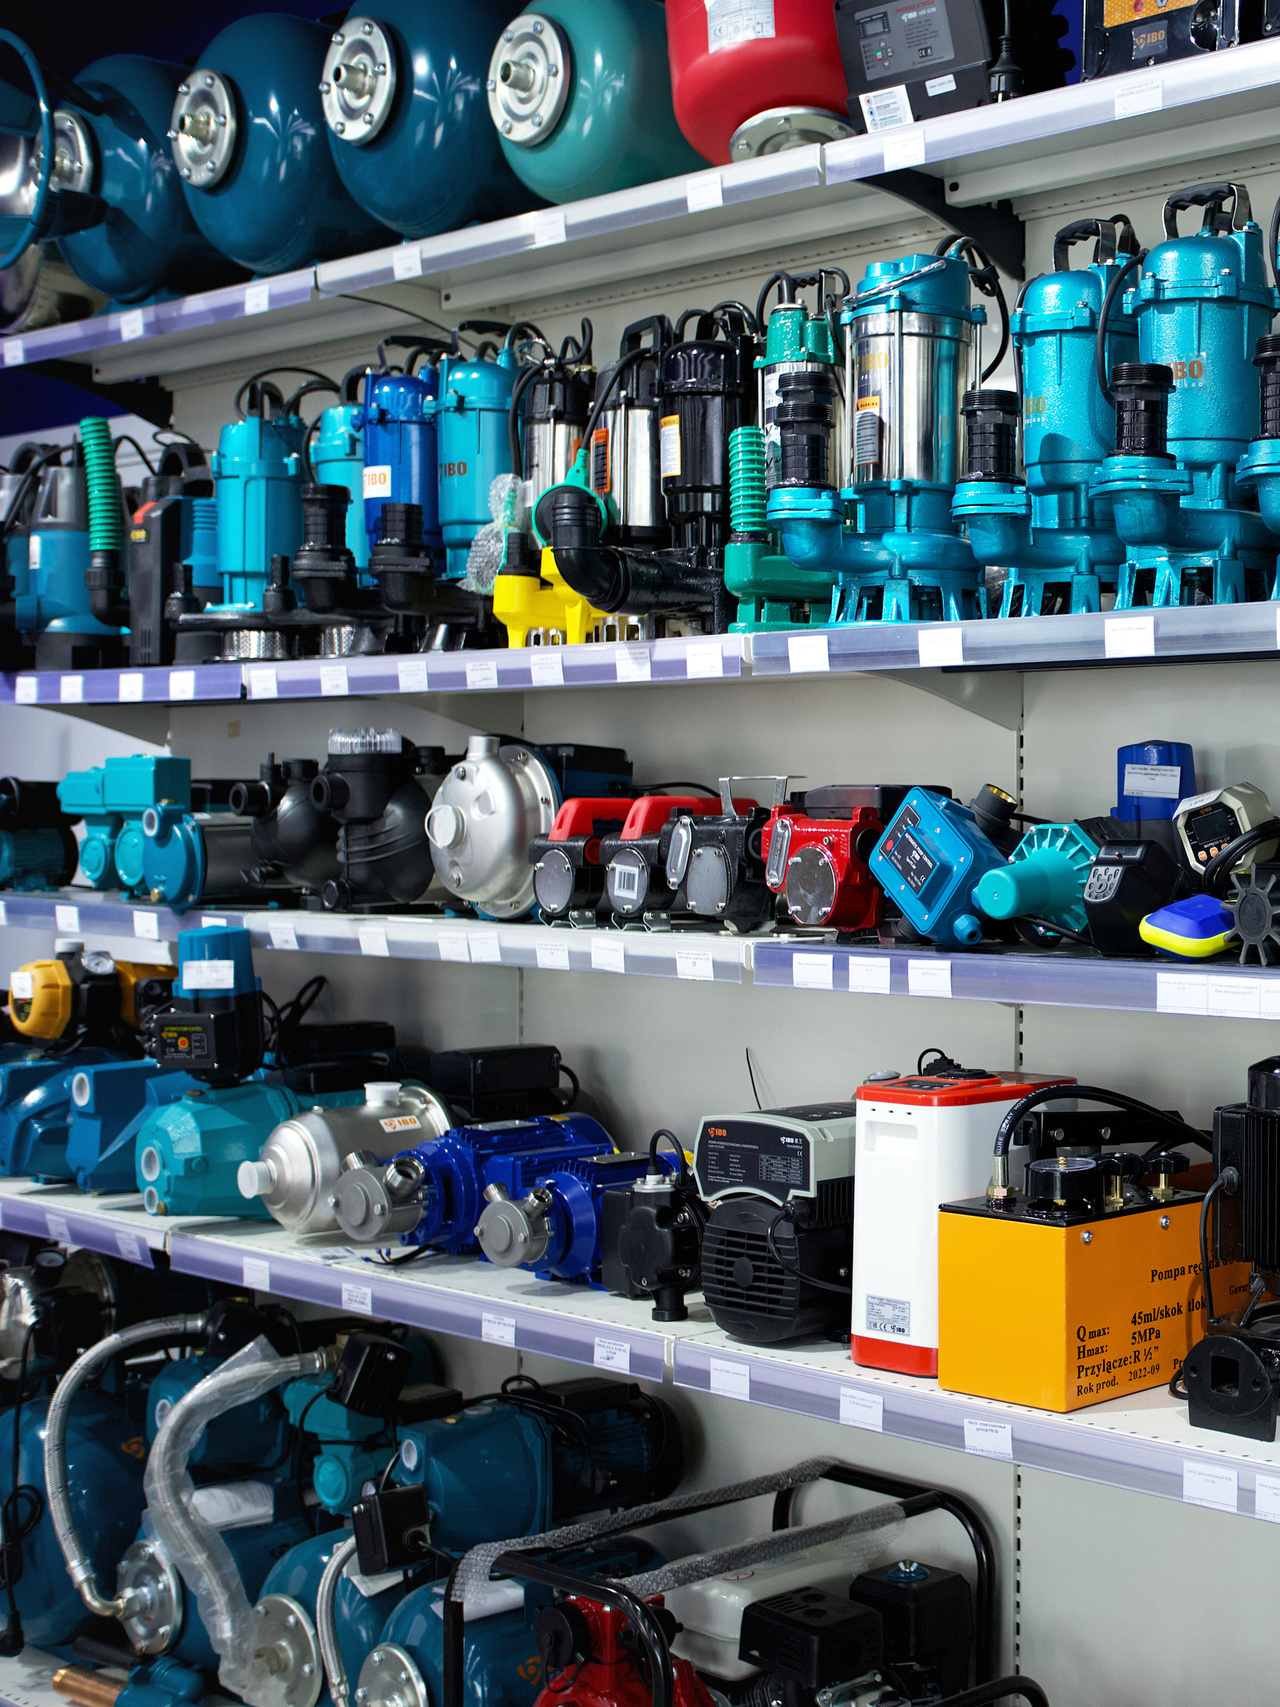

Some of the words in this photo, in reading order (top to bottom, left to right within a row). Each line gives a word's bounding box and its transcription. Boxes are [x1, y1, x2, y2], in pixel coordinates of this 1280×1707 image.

[1147, 30, 1165, 43] IBO
[1166, 360, 1203, 380] BO
[368, 472, 387, 485] IBO
[444, 461, 467, 478] IBO
[397, 1117, 417, 1126] IBO
[715, 1128, 727, 1137] IBO
[1150, 1266, 1186, 1283] Pompa
[1187, 1259, 1220, 1275] ręcna
[1130, 1302, 1183, 1326] 45ml/skok
[1076, 1325, 1087, 1343] Q
[1088, 1325, 1110, 1340] max:
[1076, 1344, 1108, 1360] Hmax:
[1130, 1327, 1161, 1345] 5MPa
[1076, 1384, 1094, 1397] Rok
[1095, 1376, 1119, 1394] prod.
[1128, 1363, 1160, 1382] 2022-09
